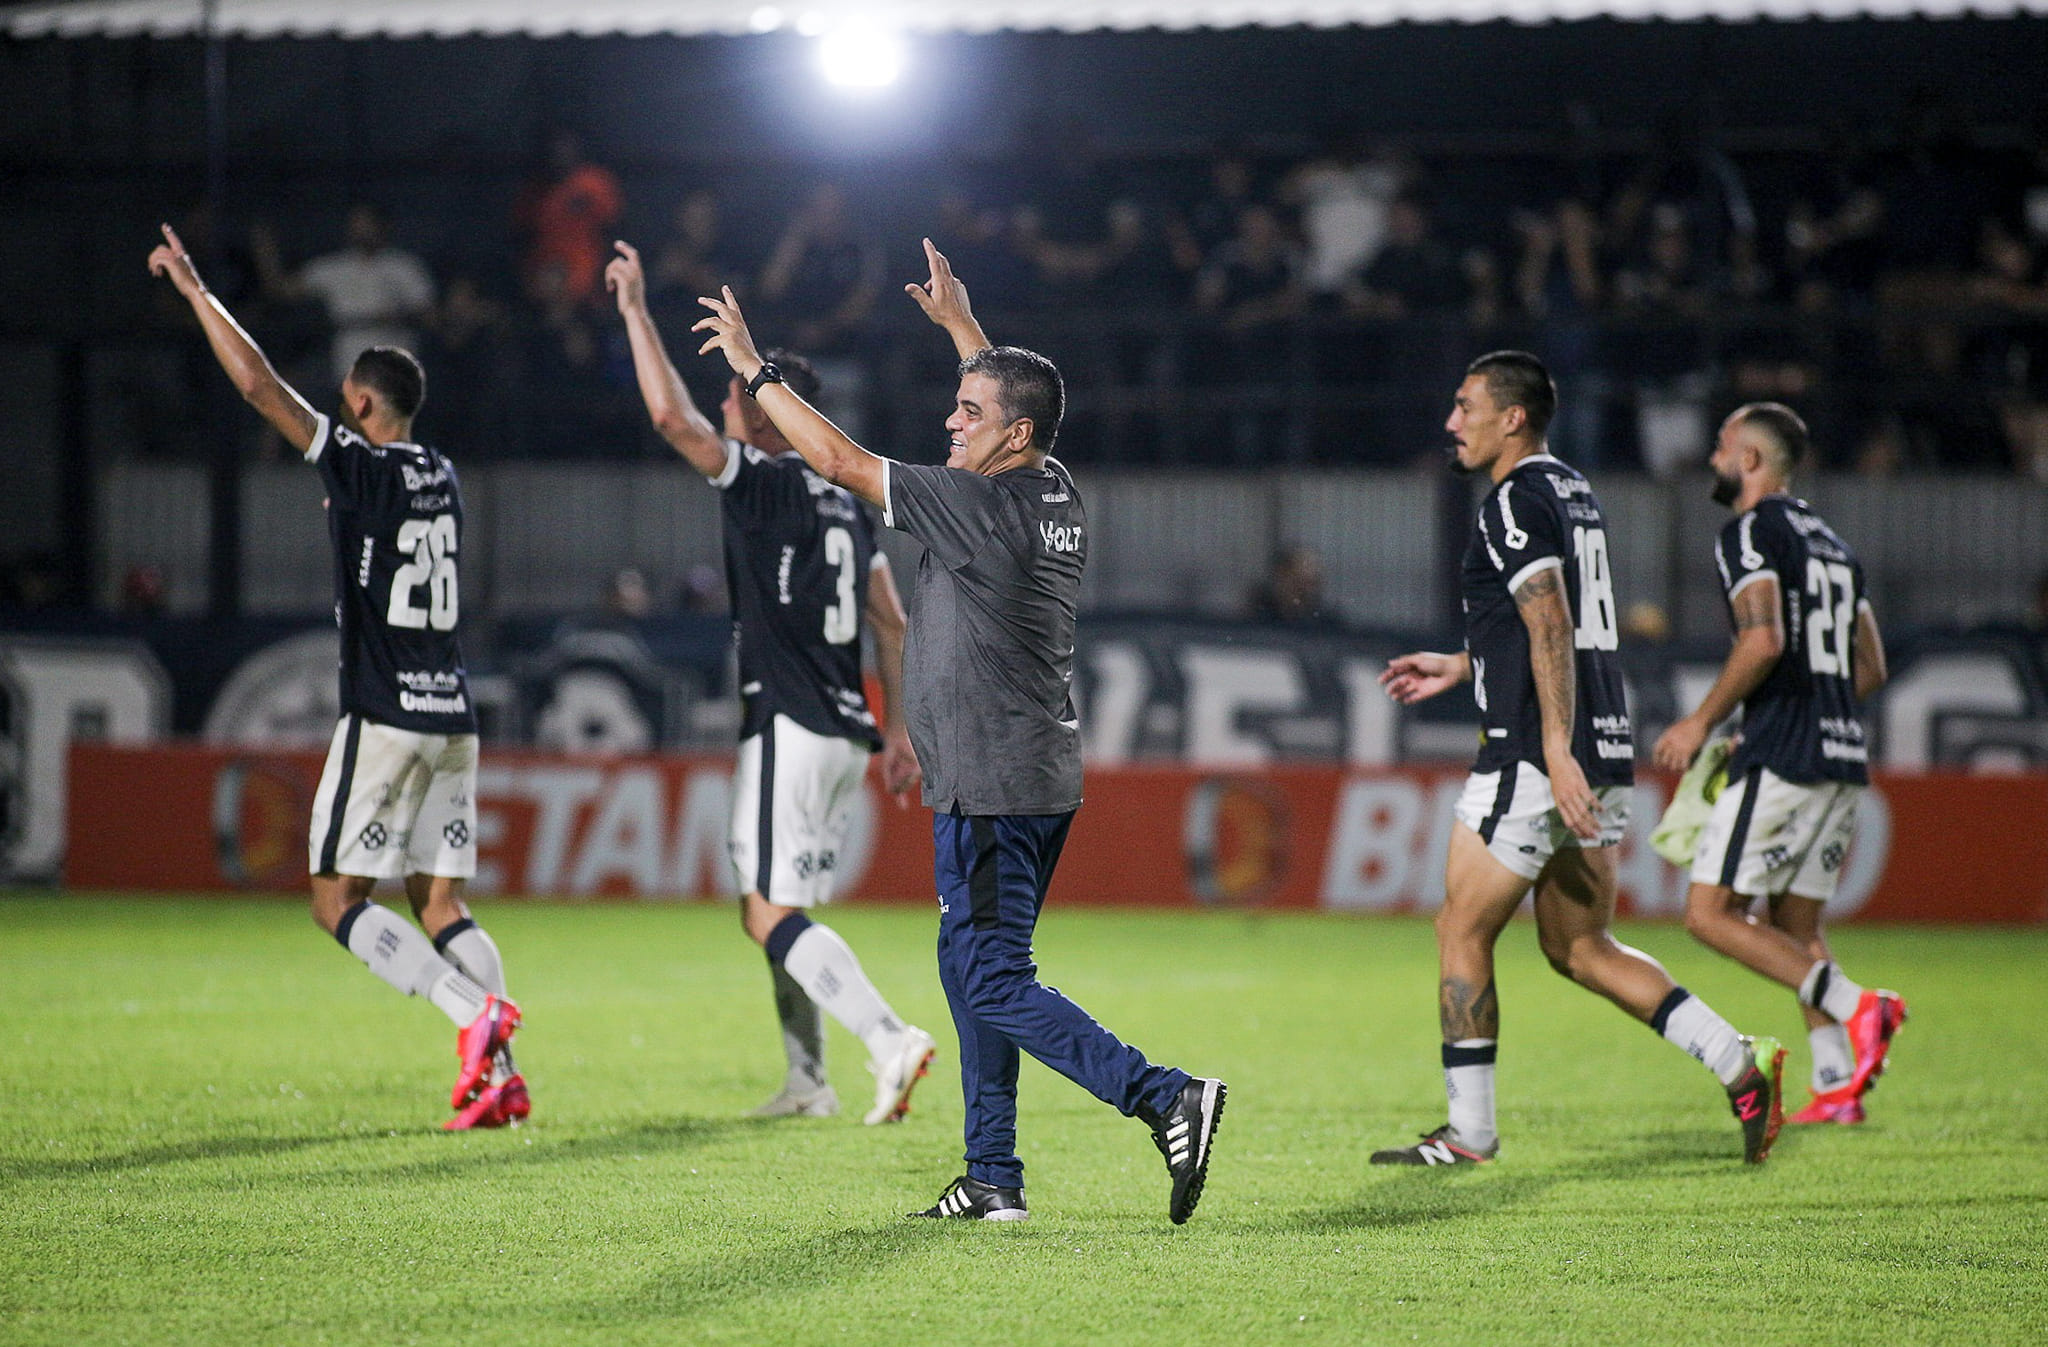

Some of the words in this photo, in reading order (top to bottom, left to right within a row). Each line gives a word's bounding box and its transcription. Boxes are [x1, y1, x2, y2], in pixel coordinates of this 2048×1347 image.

[386, 513, 459, 632] 26
[823, 527, 857, 645] 3
[1040, 520, 1081, 553] VOLT
[1573, 525, 1619, 652] 18
[1806, 557, 1855, 680] 27
